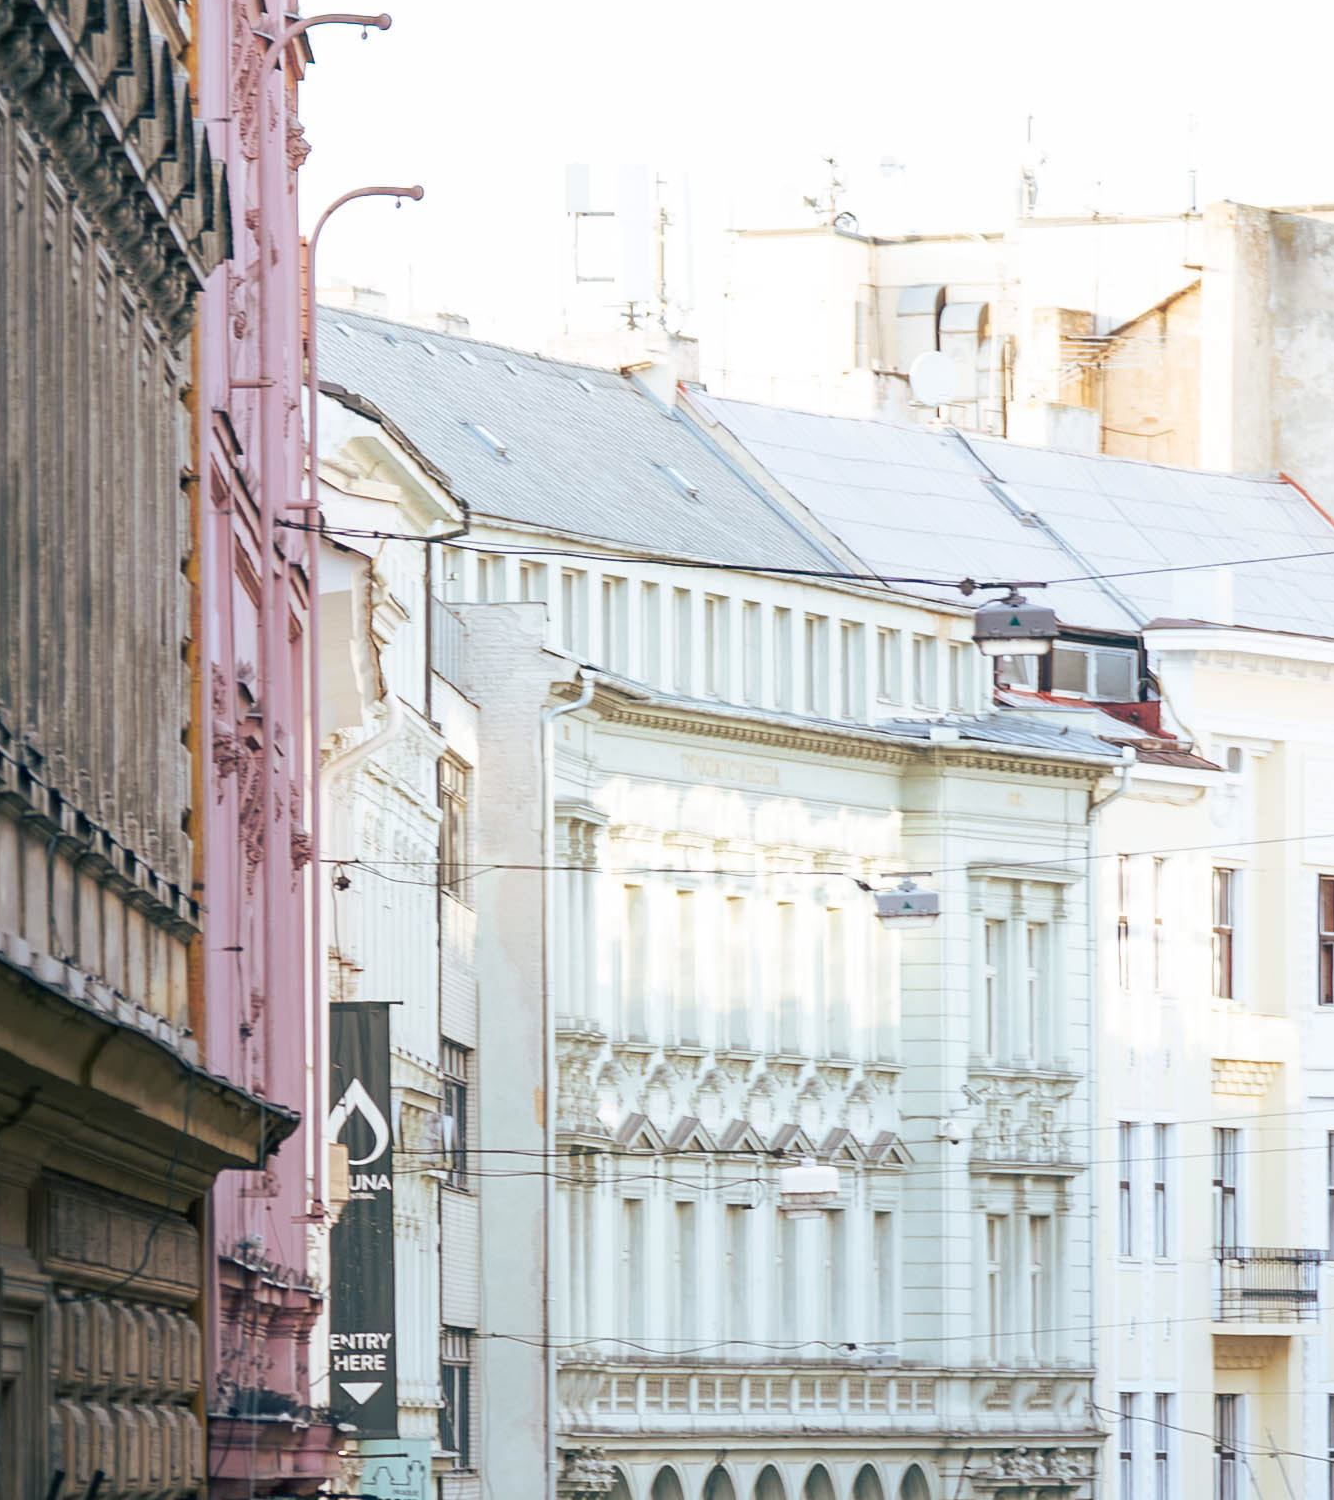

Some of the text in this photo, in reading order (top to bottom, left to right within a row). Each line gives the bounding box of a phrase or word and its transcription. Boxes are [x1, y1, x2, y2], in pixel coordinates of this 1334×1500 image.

[348, 1173, 392, 1191] UNA
[328, 1332, 393, 1350] ENTRY
[333, 1354, 388, 1371] HERE
